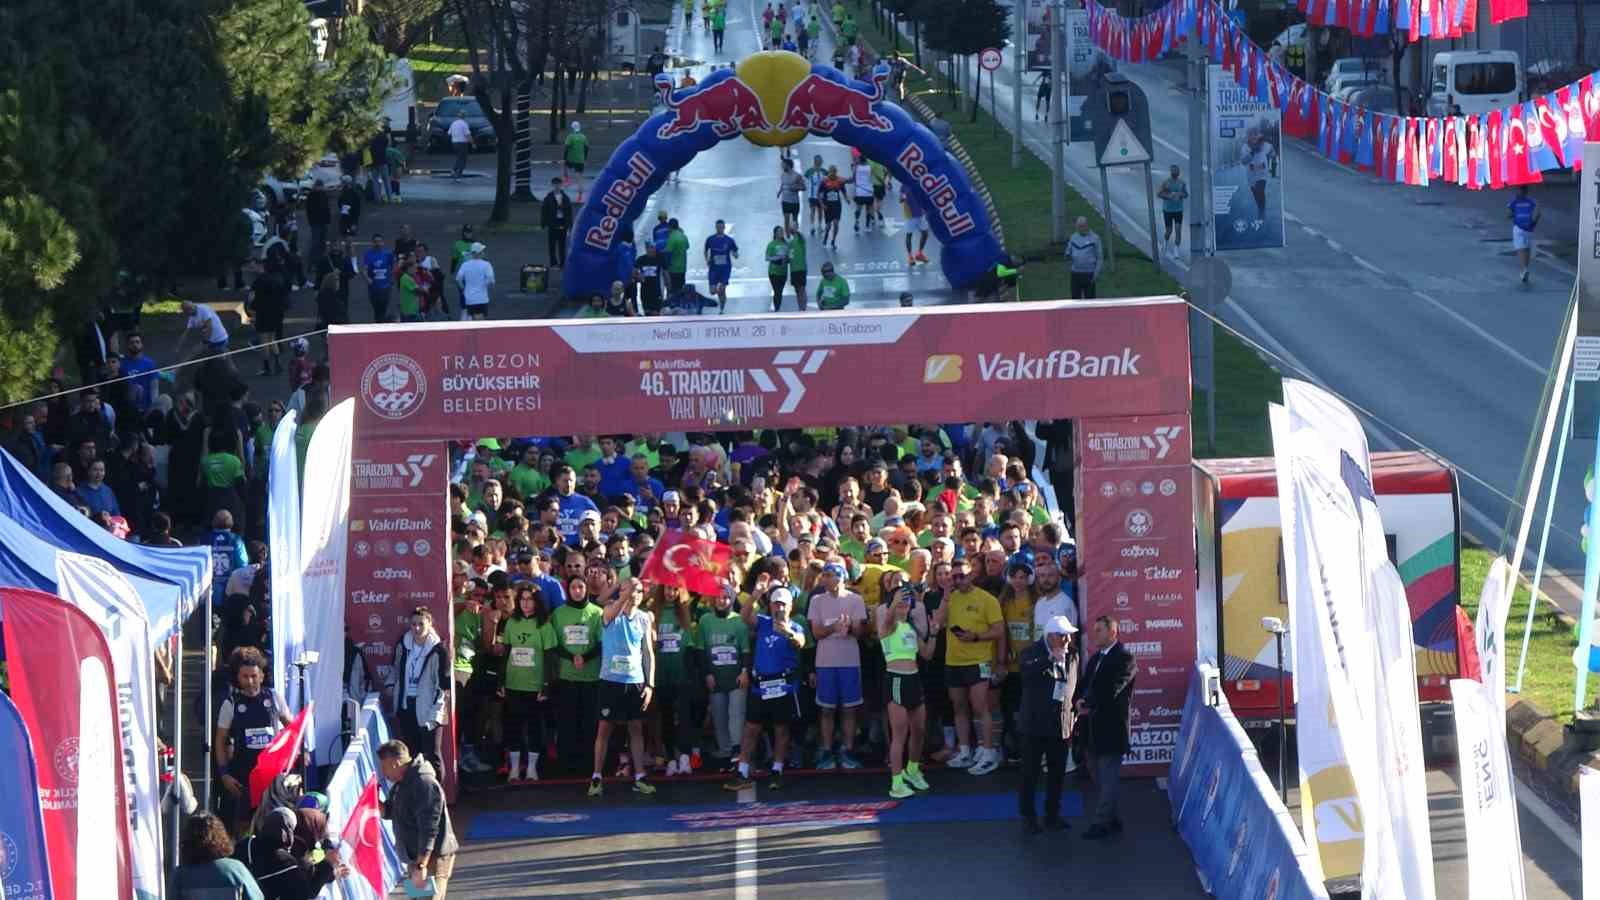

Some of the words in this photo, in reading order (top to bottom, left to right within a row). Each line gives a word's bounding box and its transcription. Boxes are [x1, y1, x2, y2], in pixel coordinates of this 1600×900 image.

[441, 353, 540, 370] TRABZON
[442, 373, 540, 392] BÜYÜKŞEHİR
[640, 369, 745, 396] 46.TRABZON
[443, 394, 542, 413] BELEDİYESİ
